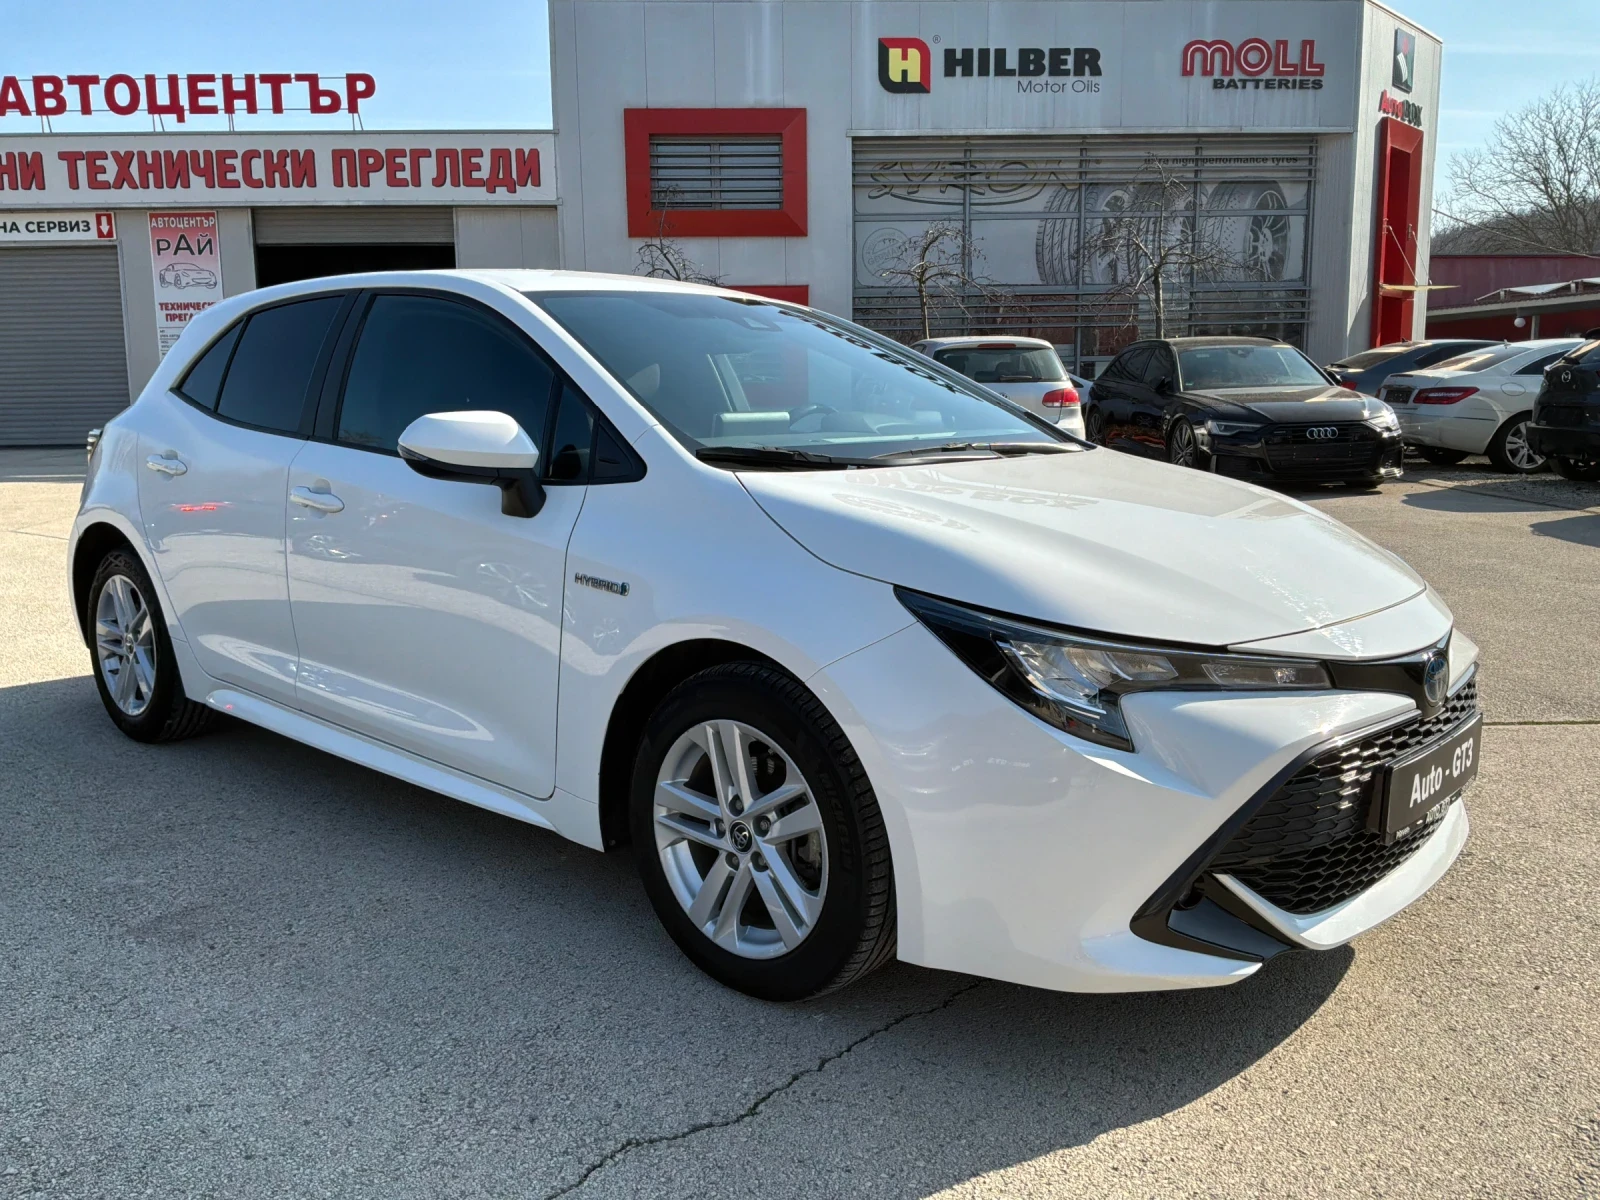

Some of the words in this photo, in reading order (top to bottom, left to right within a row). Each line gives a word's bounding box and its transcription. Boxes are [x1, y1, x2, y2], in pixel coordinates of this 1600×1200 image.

[944, 48, 1102, 77] HILBER
[1017, 80, 1067, 93] Motor
[1072, 80, 1100, 93] Oils
[1213, 78, 1324, 90] BATTERIES
[0, 73, 376, 123] АВТОЦЕНТЪР
[58, 148, 317, 190] ТЕХНИЧЕСКИ
[332, 148, 542, 194] ПРЕГЛЕДИ
[25, 220, 91, 233] СЕРВИЗ
[151, 216, 215, 229] АВТОЦЕНТЪР
[156, 233, 213, 256] РАЙ
[575, 572, 621, 595] HYBRID
[1409, 765, 1442, 808] Auto
[1452, 737, 1473, 778] GT3
